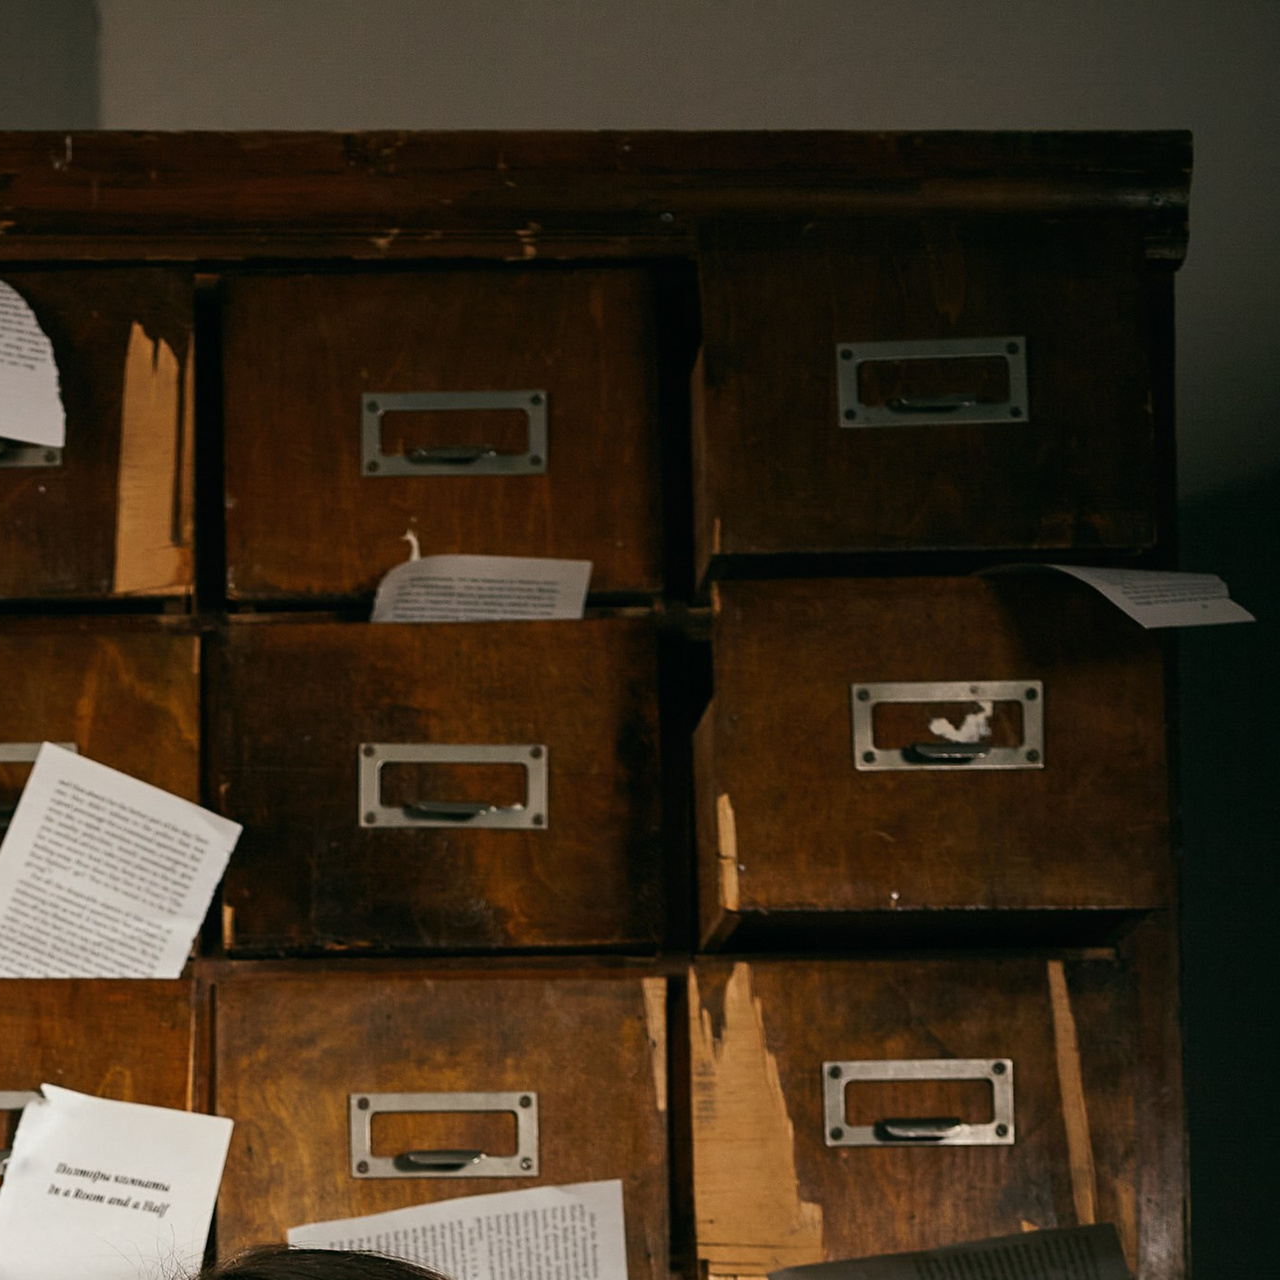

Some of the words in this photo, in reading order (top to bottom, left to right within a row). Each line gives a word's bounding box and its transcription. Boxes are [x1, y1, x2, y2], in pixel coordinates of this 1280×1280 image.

[56, 1163, 111, 1183] Полторы
[114, 1175, 170, 1192] комнаты
[48, 1184, 61, 1195] In
[63, 1189, 71, 1198] a
[73, 1188, 105, 1203] Room
[107, 1197, 131, 1208] and
[132, 1201, 140, 1210] a
[142, 1200, 171, 1218] Half
